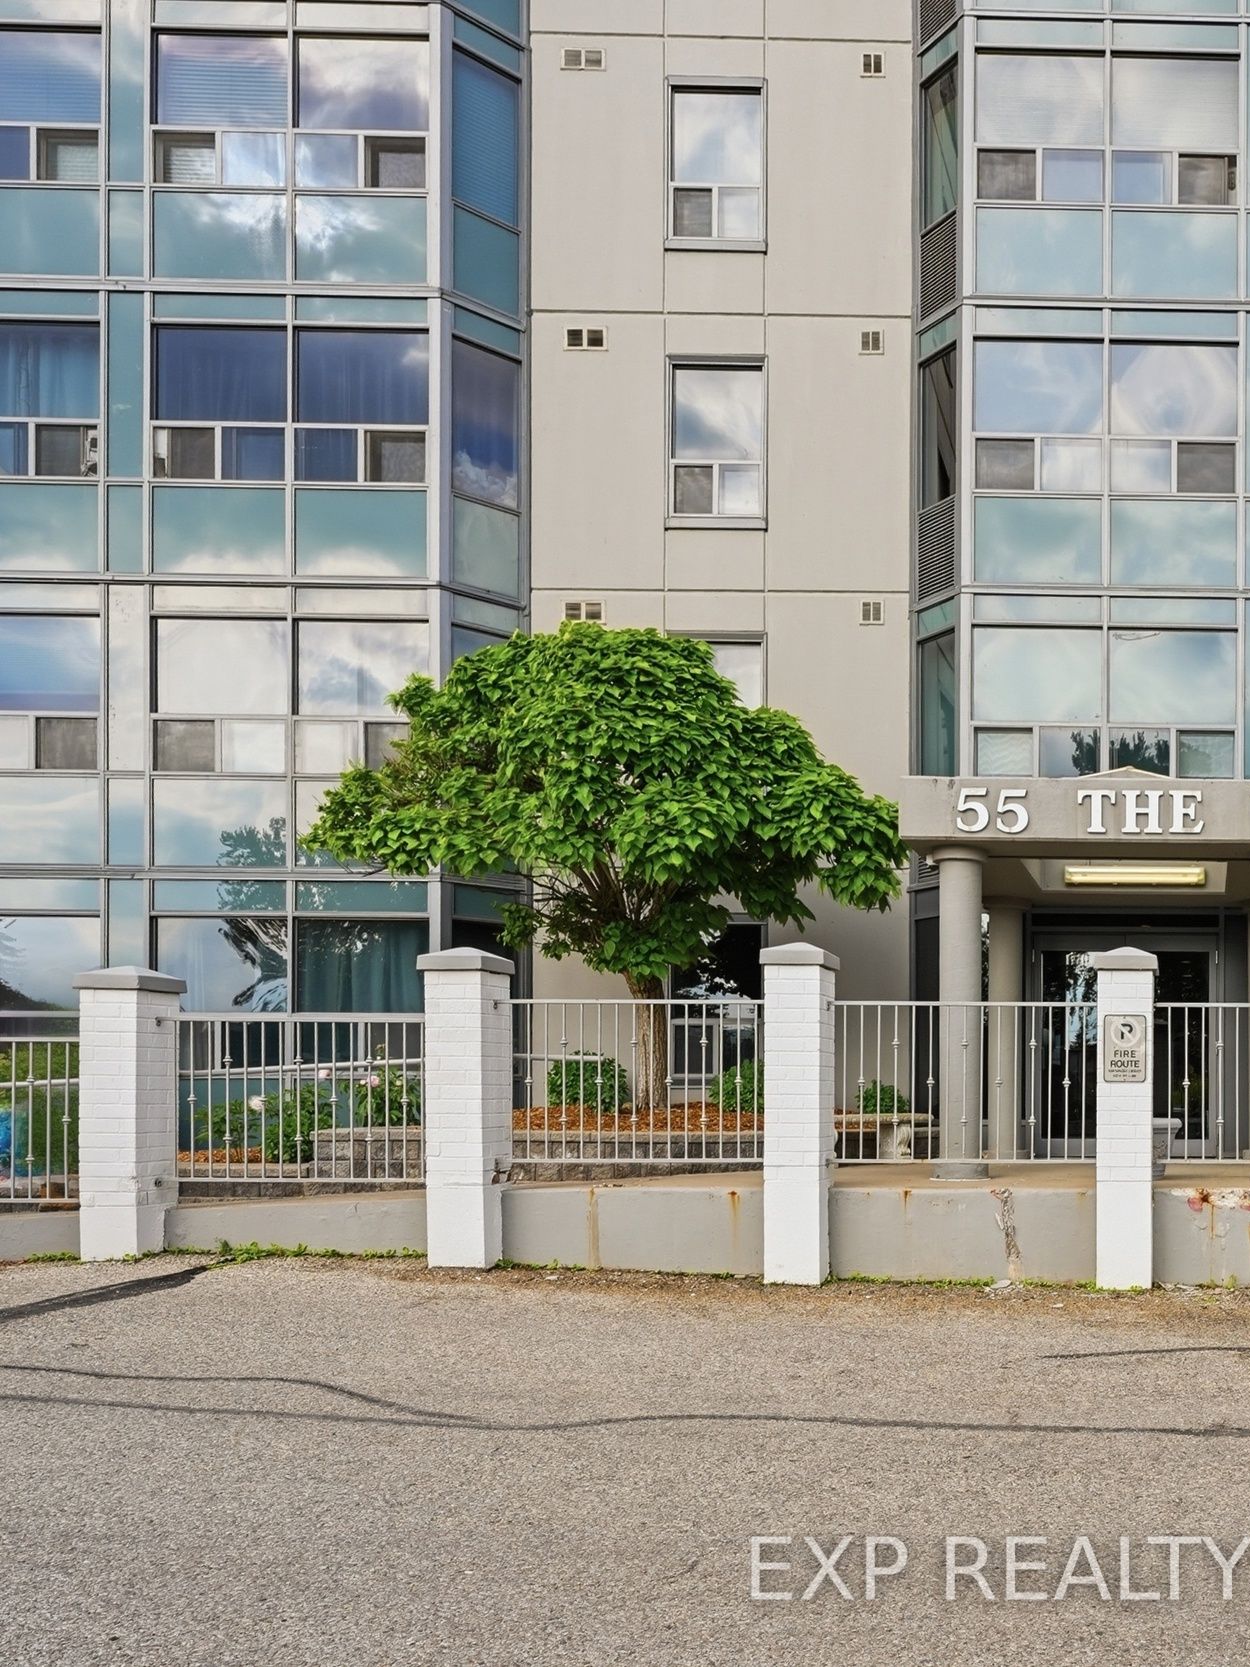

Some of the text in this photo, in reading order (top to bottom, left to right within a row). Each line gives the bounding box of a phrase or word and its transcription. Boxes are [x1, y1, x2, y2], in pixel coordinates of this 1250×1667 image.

[956, 787, 1029, 833] 55
[1077, 789, 1204, 834] THE
[1113, 1050, 1137, 1058] FIRE
[1110, 1060, 1140, 1068] ROUTE
